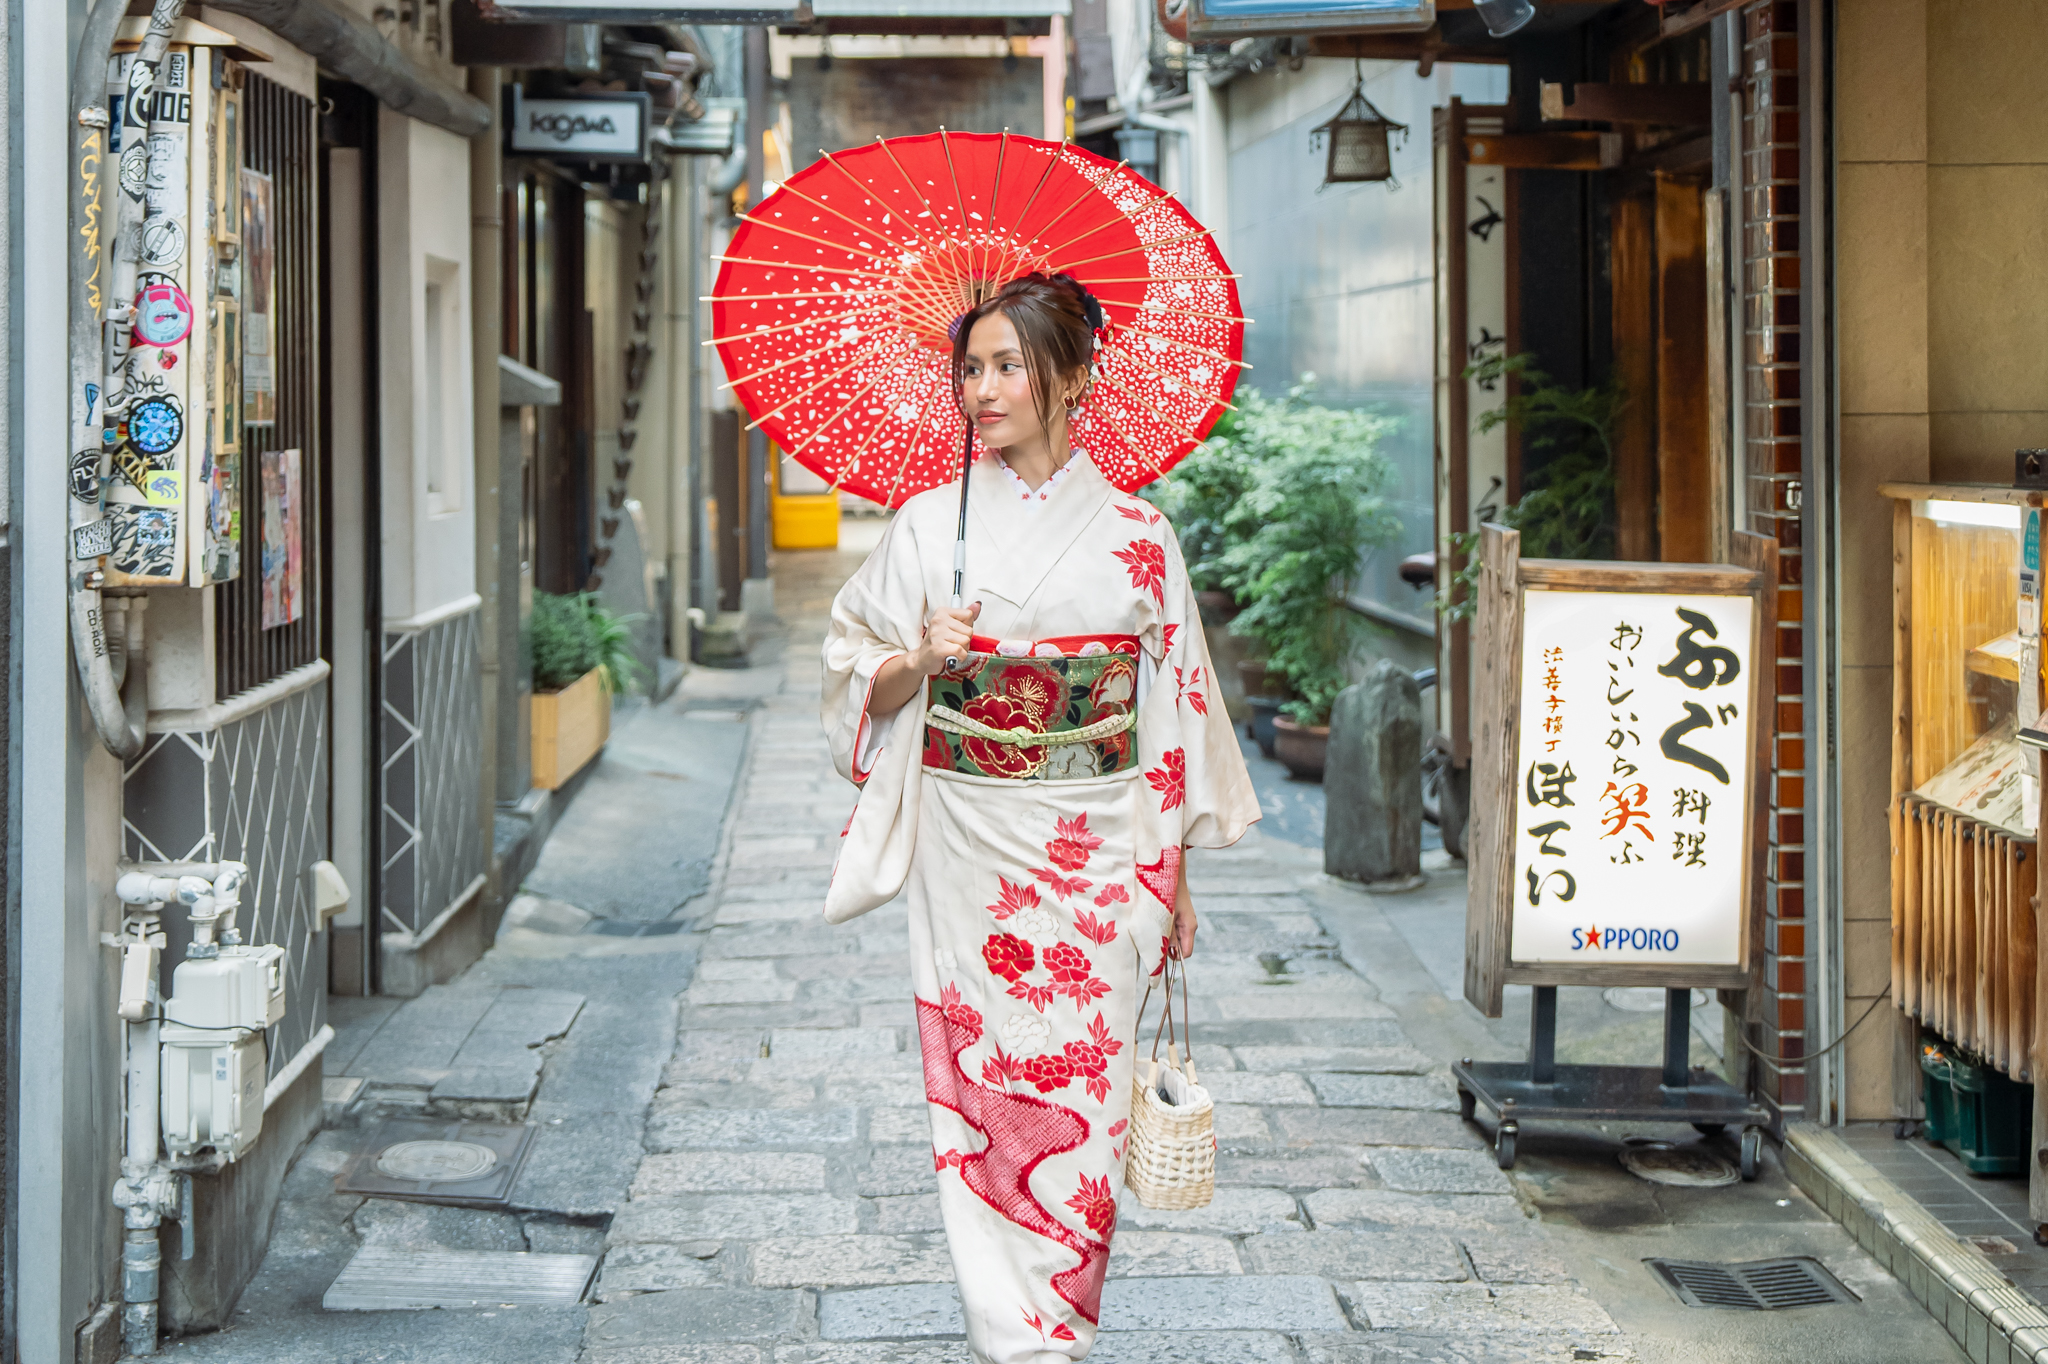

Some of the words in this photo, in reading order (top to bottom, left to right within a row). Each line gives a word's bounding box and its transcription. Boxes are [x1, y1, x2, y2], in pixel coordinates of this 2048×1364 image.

[72, 461, 101, 481] FLY
[79, 543, 110, 556] NOODLE
[1600, 621, 1655, 865] おいしいから笑ふ
[1526, 759, 1577, 906] ほてい
